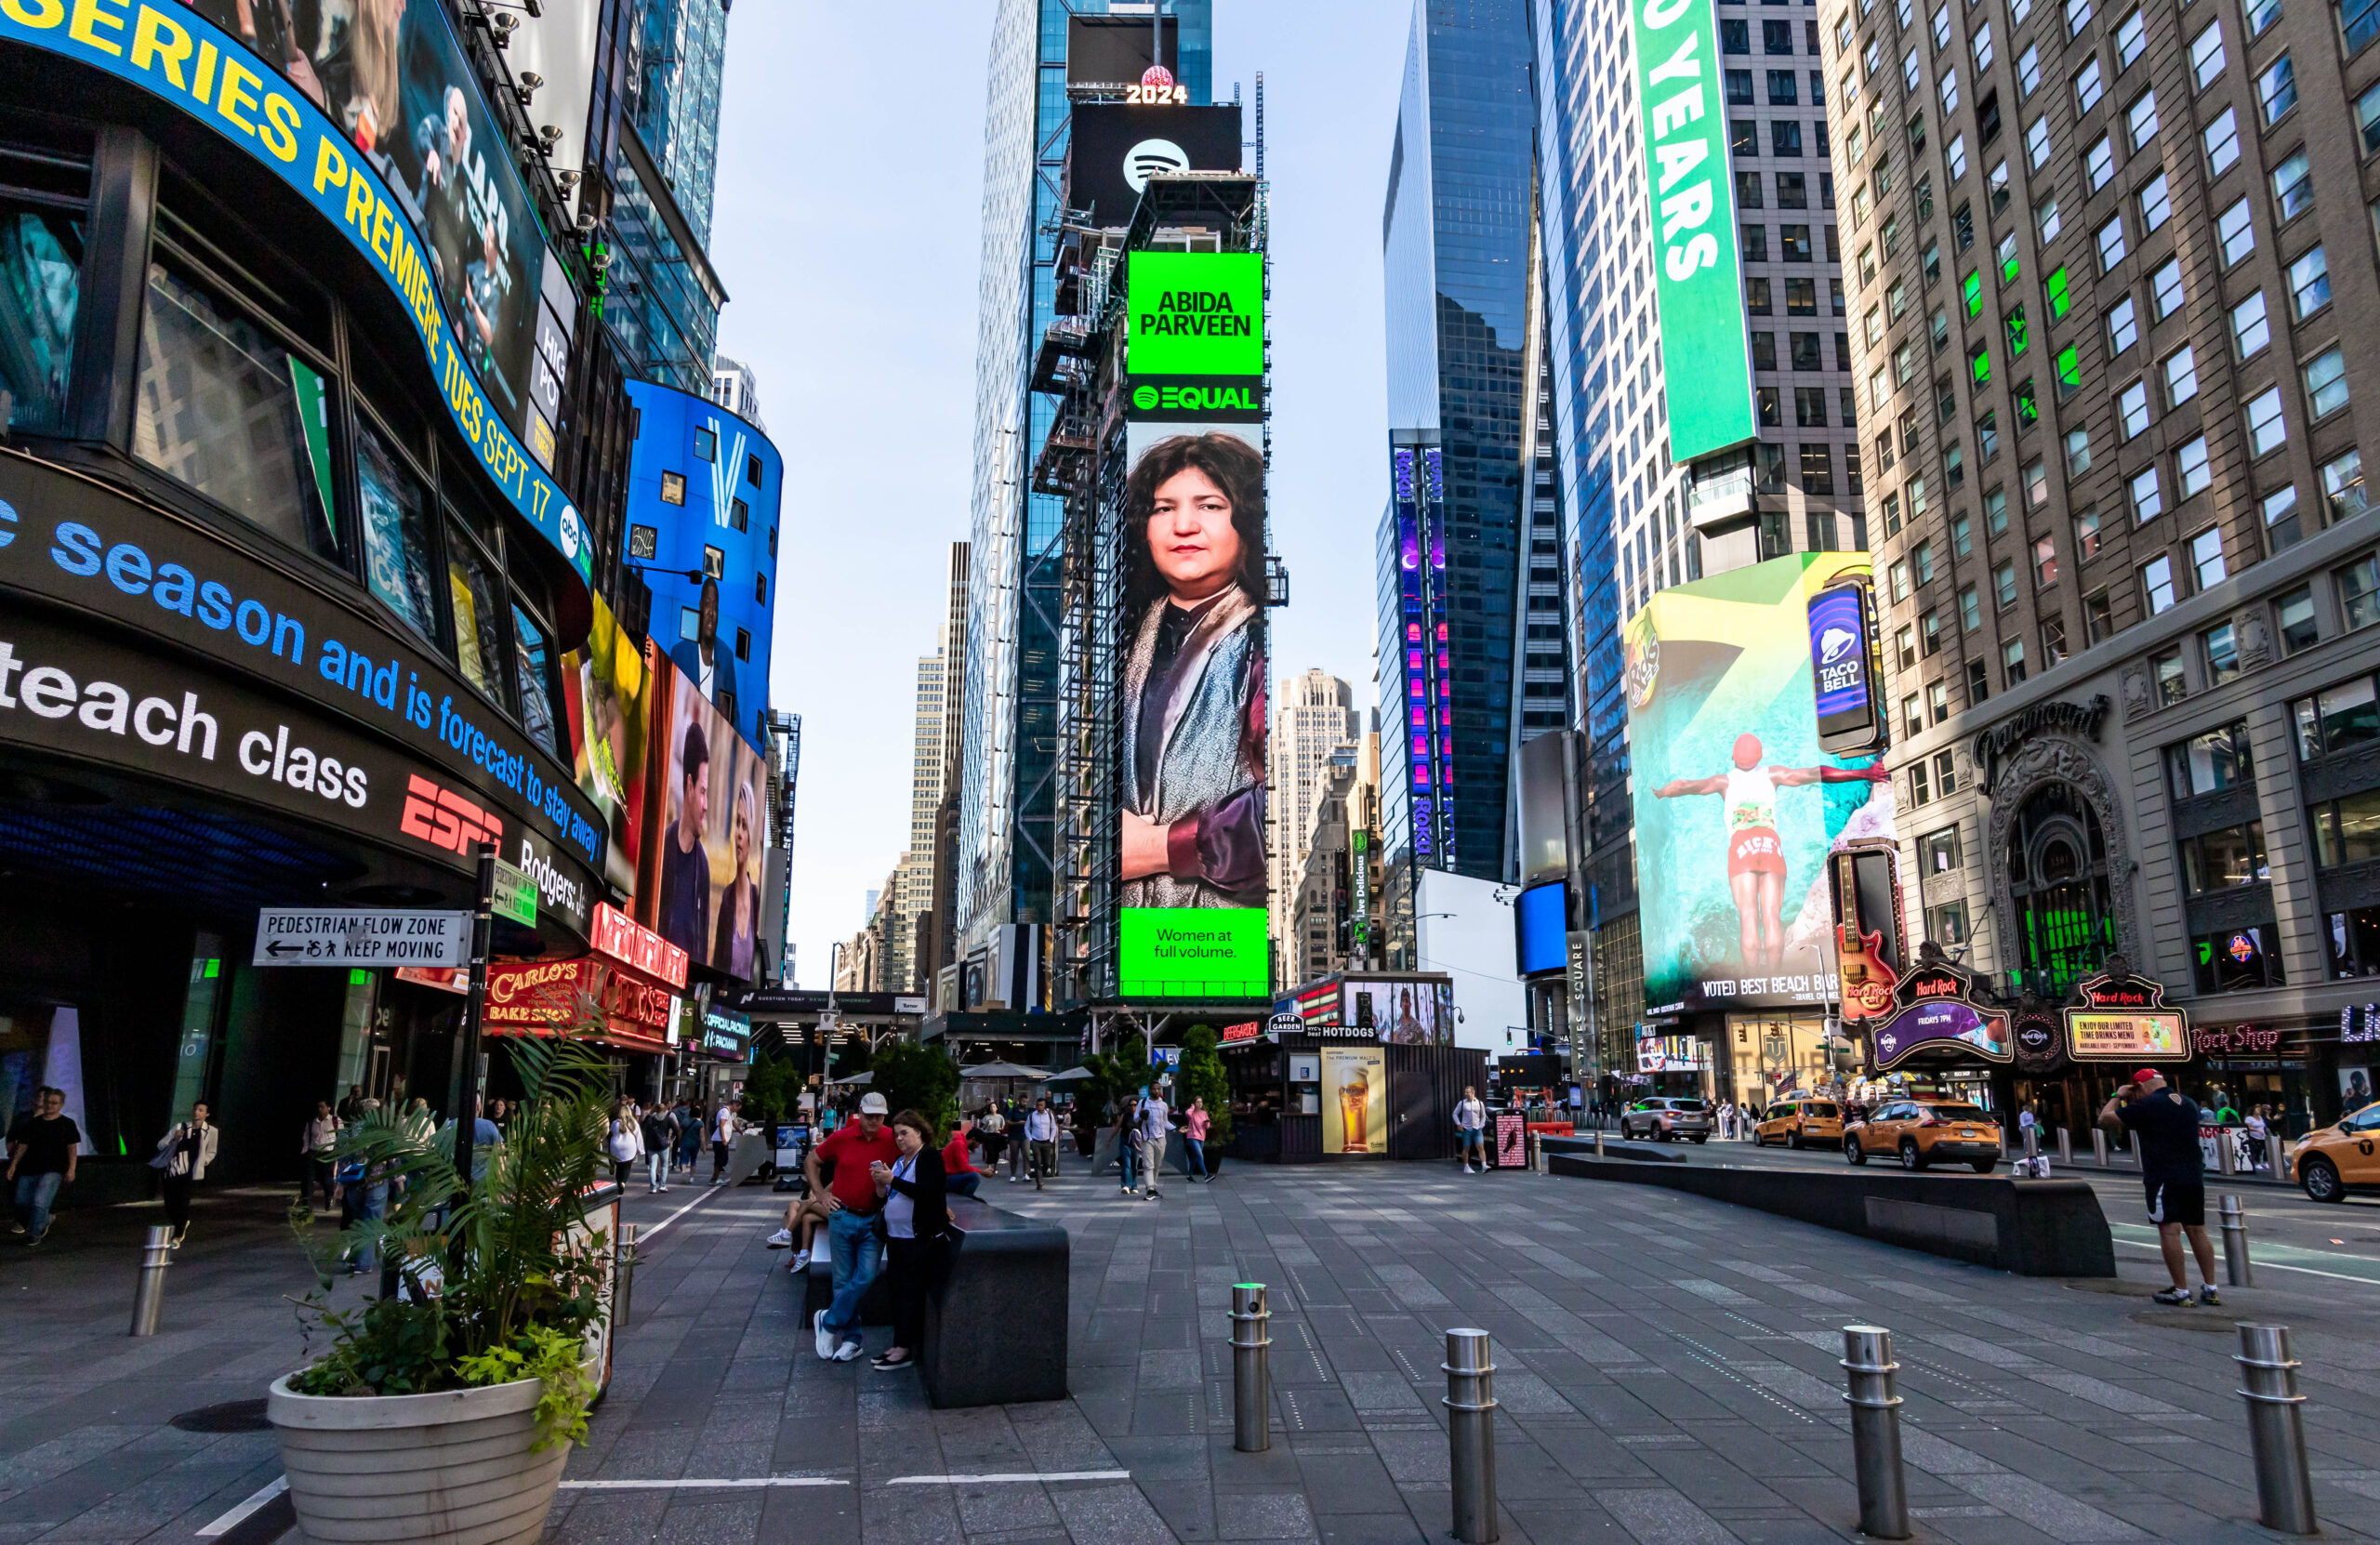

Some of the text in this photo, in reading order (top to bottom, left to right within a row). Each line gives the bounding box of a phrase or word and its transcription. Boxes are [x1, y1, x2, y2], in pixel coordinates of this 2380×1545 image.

[1126, 85, 1188, 104] 2024
[1648, 30, 1718, 282] YEARS
[0, 0, 550, 522] SERIES PREMIERE TUES SEPT 17
[1158, 291, 1234, 312] ABIDA
[1141, 314, 1250, 336] PARVEEN
[1162, 387, 1258, 410] EQUAL
[562, 517, 577, 545] abc
[1819, 660, 1858, 680] TACO
[50, 522, 305, 665] season
[320, 640, 400, 710] and
[405, 671, 431, 730] is
[439, 695, 524, 794] forecast
[526, 763, 542, 807] to
[545, 786, 569, 839] stay
[571, 812, 598, 863] away
[1823, 673, 1860, 693] BELL
[0, 640, 367, 809] teach class
[400, 773, 503, 858] ESPN
[521, 839, 575, 911] Rodgers:
[1355, 855, 1366, 898] Delicious
[1356, 899, 1366, 918] Live
[267, 917, 446, 935] PEDESTRIAN FLOW ZONE
[1157, 929, 1232, 942] Women at
[344, 940, 443, 958] KEEP MOVING
[1155, 945, 1236, 958] full volume.
[1572, 943, 1584, 1000] SQUARE
[492, 962, 578, 1003] CARLO'S
[1702, 973, 1839, 997] VOTED BEST BEACH BAR
[1846, 984, 1869, 997] Hard
[1916, 977, 1957, 997] Hard Rock
[2092, 991, 2145, 1005] Hard Rock
[490, 1007, 528, 1020] BAKE
[1918, 1014, 1950, 1025] FRIDAYS 7PM
[1323, 1027, 1374, 1037] HOTDOGS
[1641, 1024, 1657, 1037] AT&T
[2033, 1032, 2048, 1040] Rock
[2079, 1022, 2134, 1030] ENJOY OUR LIMITED
[2080, 1031, 2135, 1039] TIME DRINKS MENU
[715, 1037, 737, 1051] PACMAN
[2191, 1024, 2281, 1053] Rock Shop
